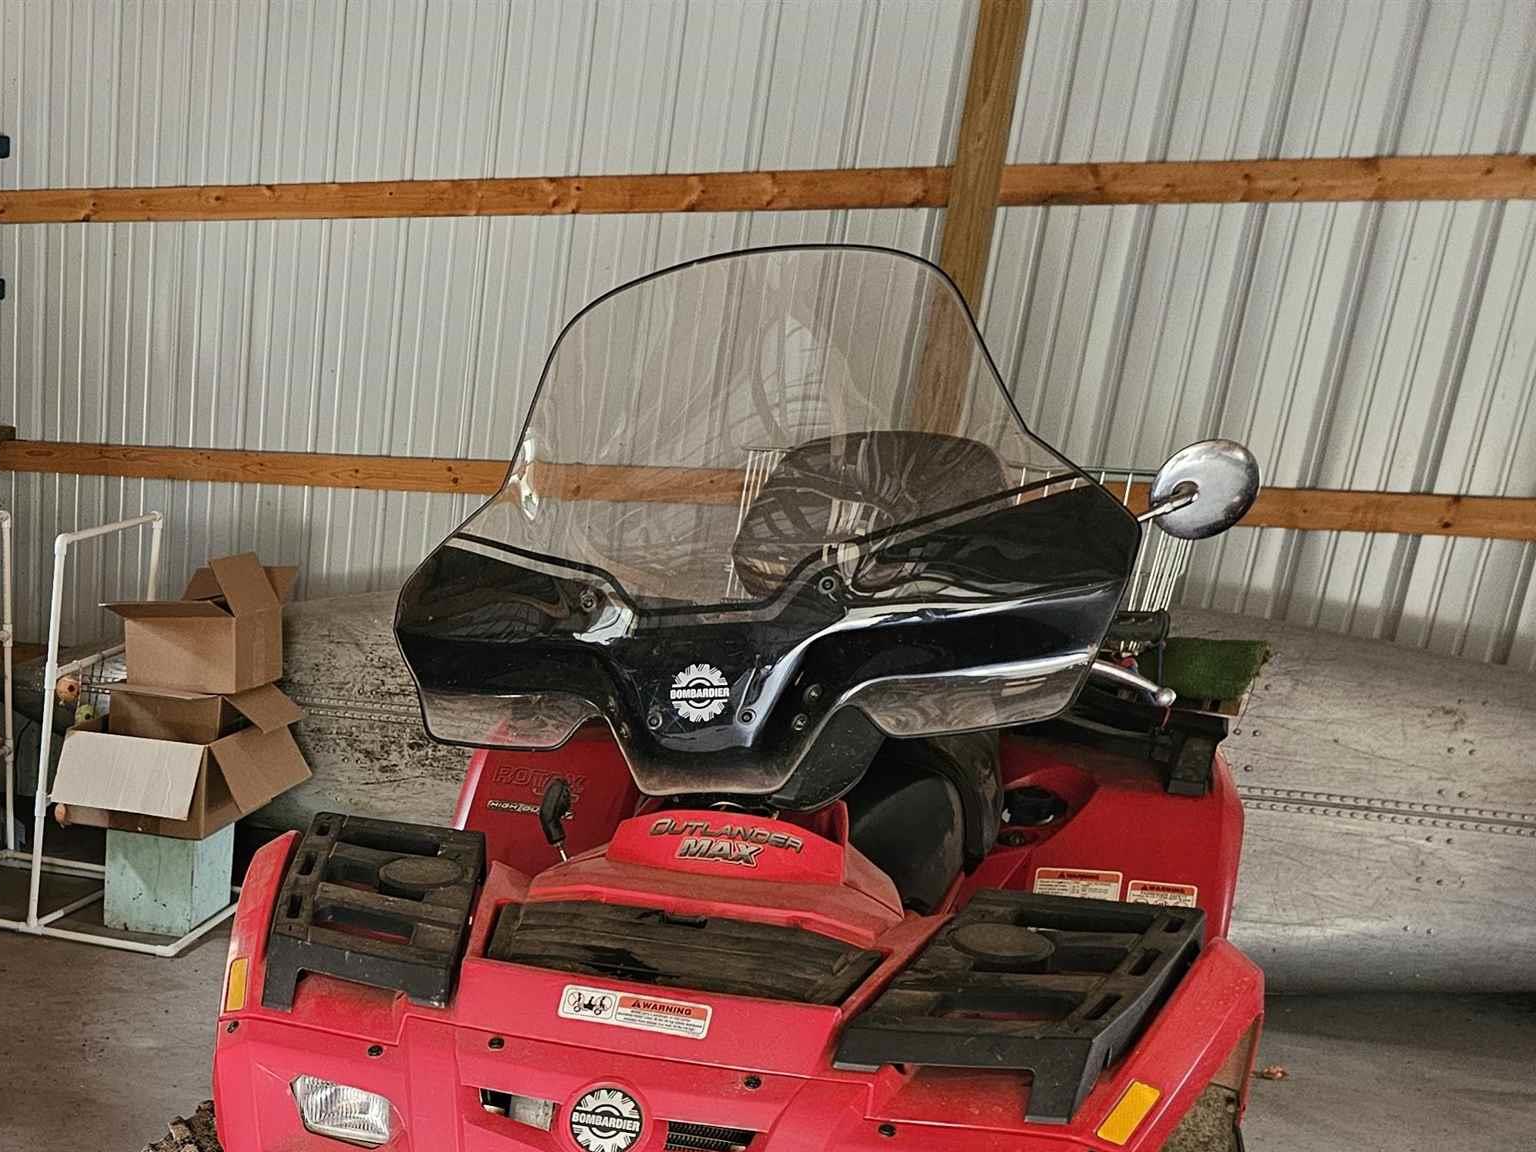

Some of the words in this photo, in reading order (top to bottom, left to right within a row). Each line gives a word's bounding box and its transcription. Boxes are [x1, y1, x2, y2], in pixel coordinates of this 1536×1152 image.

[670, 687, 730, 699] BOMBARDIER
[650, 818, 805, 853] OUTLANDER
[677, 838, 762, 867] MAX
[642, 1000, 693, 1016] WARNING
[572, 1112, 641, 1132] BOMBARDIER
